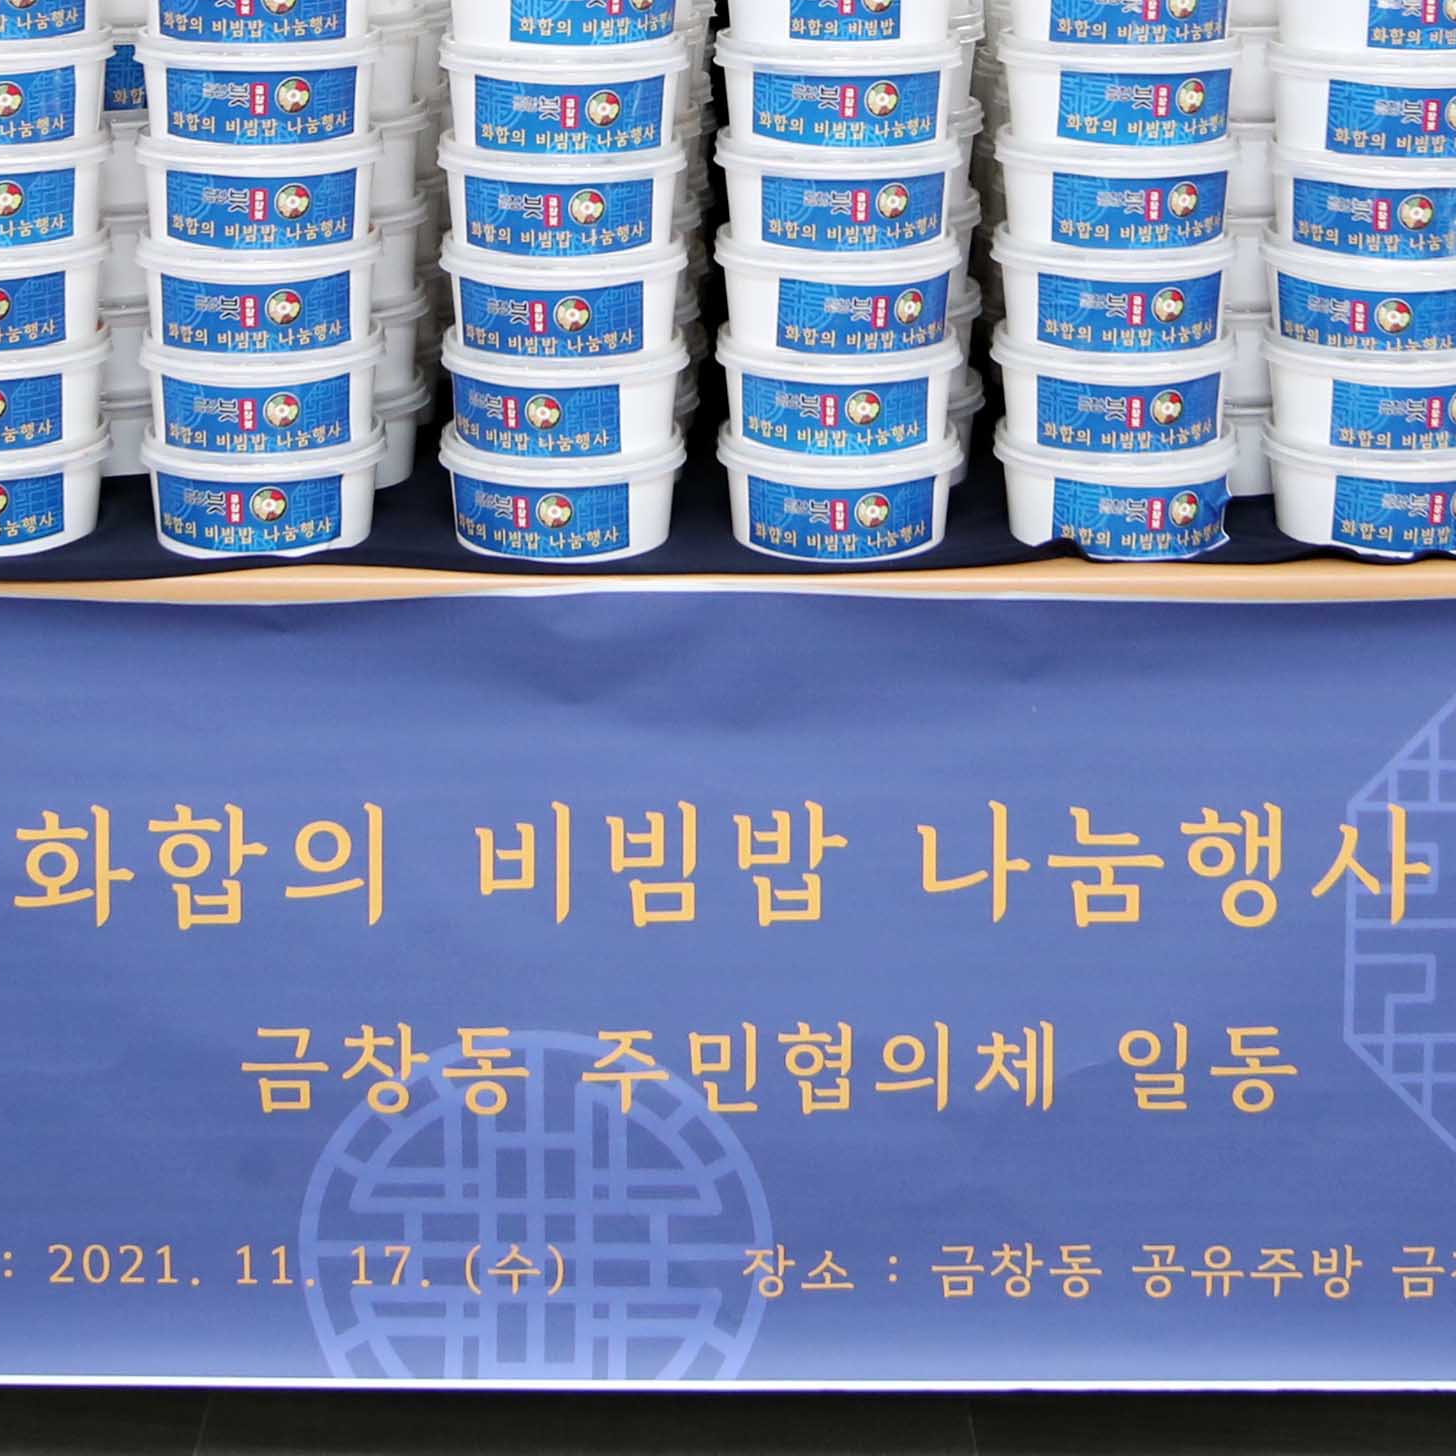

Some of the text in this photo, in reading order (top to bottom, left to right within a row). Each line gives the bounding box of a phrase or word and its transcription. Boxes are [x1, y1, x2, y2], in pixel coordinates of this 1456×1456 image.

[16, 8, 78, 29] 나눔행사
[164, 12, 338, 38] 화합의 비빔밥 나눔행사
[520, 16, 572, 36] 화합의
[583, 19, 630, 37] 비빔밥
[792, 18, 894, 36] 화합의 비빔밥
[1056, 18, 1106, 39] 화합의
[1118, 23, 1168, 42] 비빔밥
[0, 115, 66, 138] 나눔행사
[173, 112, 348, 138] 화합의 비빔밥 나눔행사
[482, 124, 655, 149] 화합의 비빔밥 나눔행사
[759, 112, 804, 134] 화합의
[814, 120, 866, 140] 비빔밥
[1066, 114, 1117, 134] 화합의
[1128, 120, 1176, 138] 비빔밥
[1334, 128, 1386, 150] 화합의
[1397, 135, 1446, 154] 비빔밥
[0, 214, 66, 237] 나눔행사
[172, 214, 347, 243] 화합의 비빔밥 나눔행사
[472, 221, 644, 247] 화합의 비빔밥 나눔행사
[768, 218, 816, 240] 화합의
[827, 224, 879, 244] 비빔밥
[1059, 219, 1110, 240] 화합의
[1120, 224, 1170, 243] 비빔밥
[1298, 221, 1338, 244] 화합의
[1348, 234, 1400, 252] 비빔밥
[168, 323, 342, 350] 화합의 비빔밥 나눔행사
[508, 336, 558, 354] 비빔밥
[567, 328, 635, 353] 나눔행사
[785, 325, 836, 347] 화합의
[847, 331, 896, 349] 비빔밥
[1045, 319, 1092, 342] 화합의
[1102, 327, 1152, 347] 비빔밥
[170, 421, 341, 452] 화합의 비빔밥 나눔행사
[487, 430, 609, 451] 비빔밥 나눔행사
[748, 415, 920, 448] 화합의 비빔밥 나눔행사
[1044, 423, 1091, 445] 화합의
[1101, 430, 1152, 449] 비빔밥
[1339, 427, 1391, 448] 화합의
[205, 524, 255, 544] 비빔밥
[264, 516, 332, 542] 나눔행사
[494, 528, 540, 549] 비빔밥
[549, 527, 619, 550] 나눔행사
[755, 521, 797, 546] 화합의
[807, 533, 858, 552] 비빔밥
[1060, 524, 1172, 551] 화합의 비빔밥
[1341, 520, 1450, 545] 화합의 비빔밥
[14, 799, 1431, 929] 화합의 비빔밥 나눔행사
[241, 1020, 1298, 1115] 금창동 주민협의체 일동
[48, 1244, 200, 1285] 2021.
[350, 1245, 432, 1286] 17.
[464, 1244, 565, 1295] (수)
[742, 1244, 855, 1296] 장소
[931, 1243, 1103, 1298] 금창동
[1132, 1244, 1362, 1299] 공유주방
